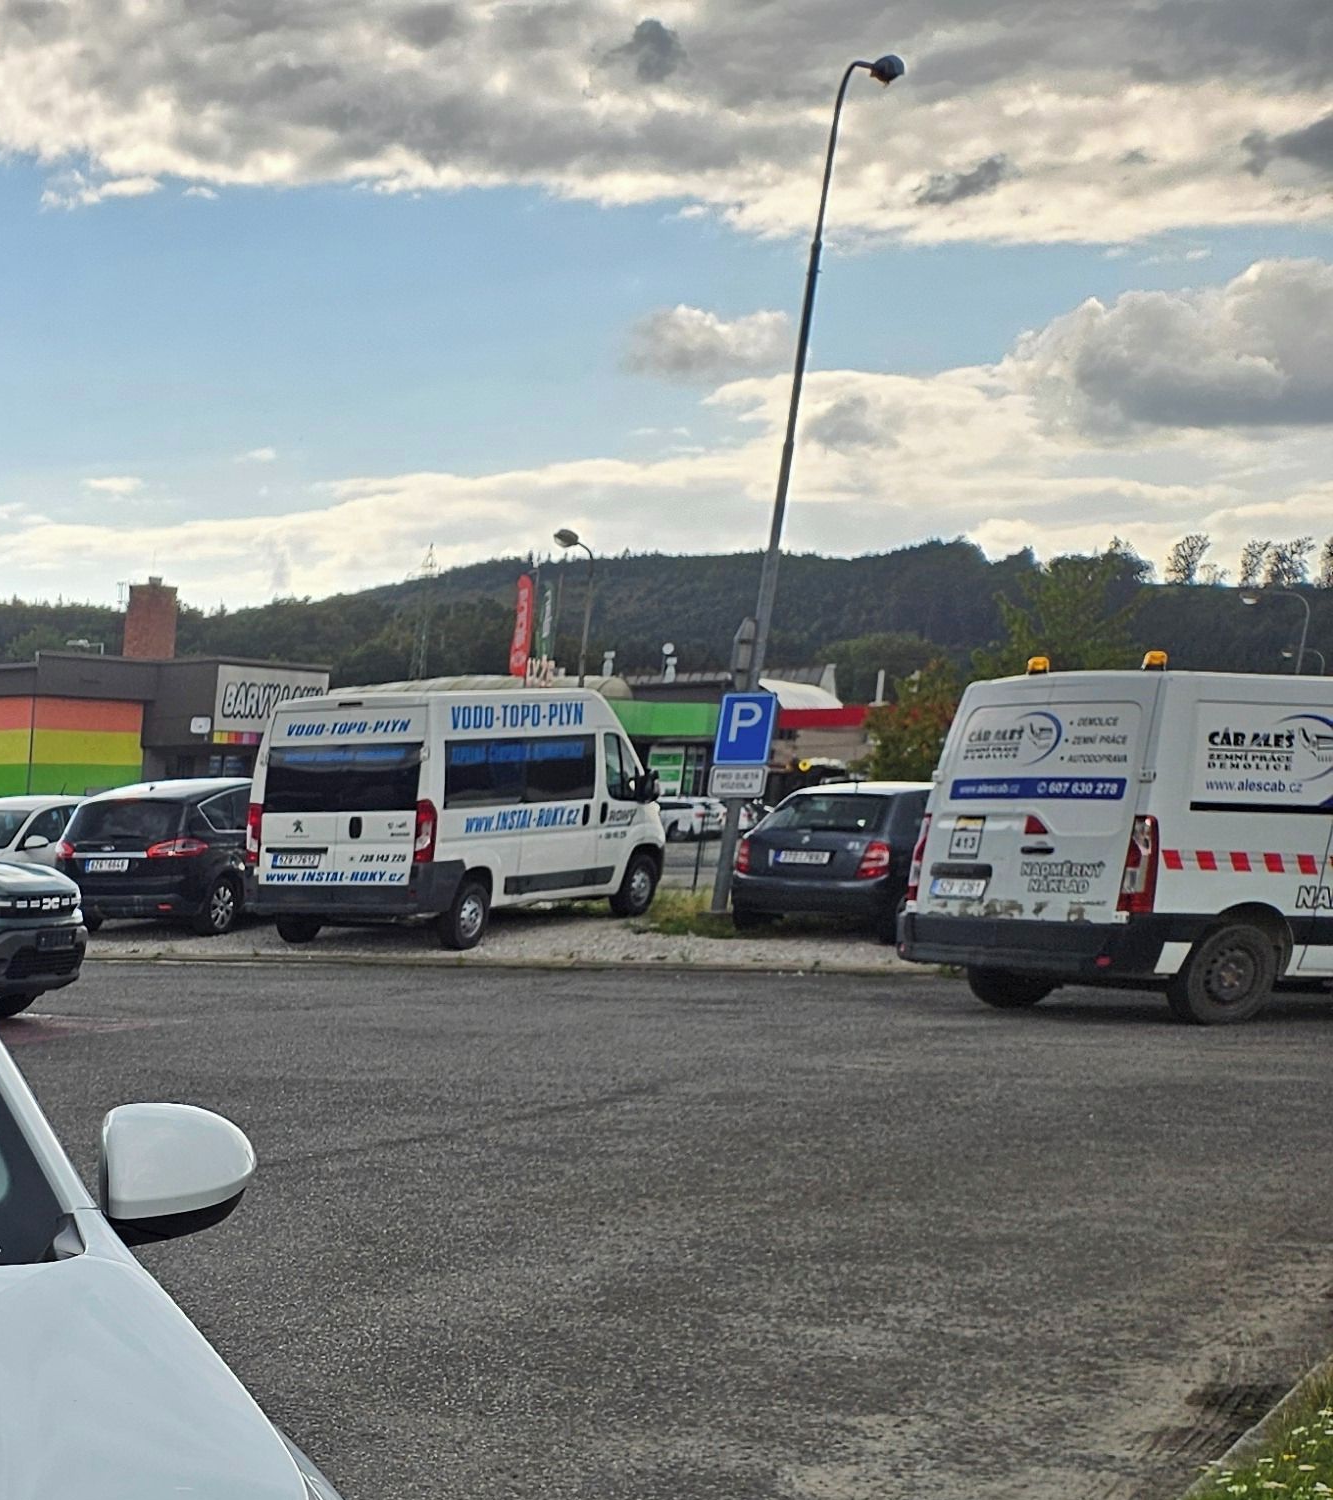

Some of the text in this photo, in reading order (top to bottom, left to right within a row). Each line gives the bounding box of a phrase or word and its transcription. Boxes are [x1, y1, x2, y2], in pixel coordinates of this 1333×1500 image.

[728, 702, 763, 743] P
[1048, 781, 1119, 795] 607 630 278
[1206, 778, 1304, 794] www.alescab.cz
[1295, 885, 1333, 909] NA
